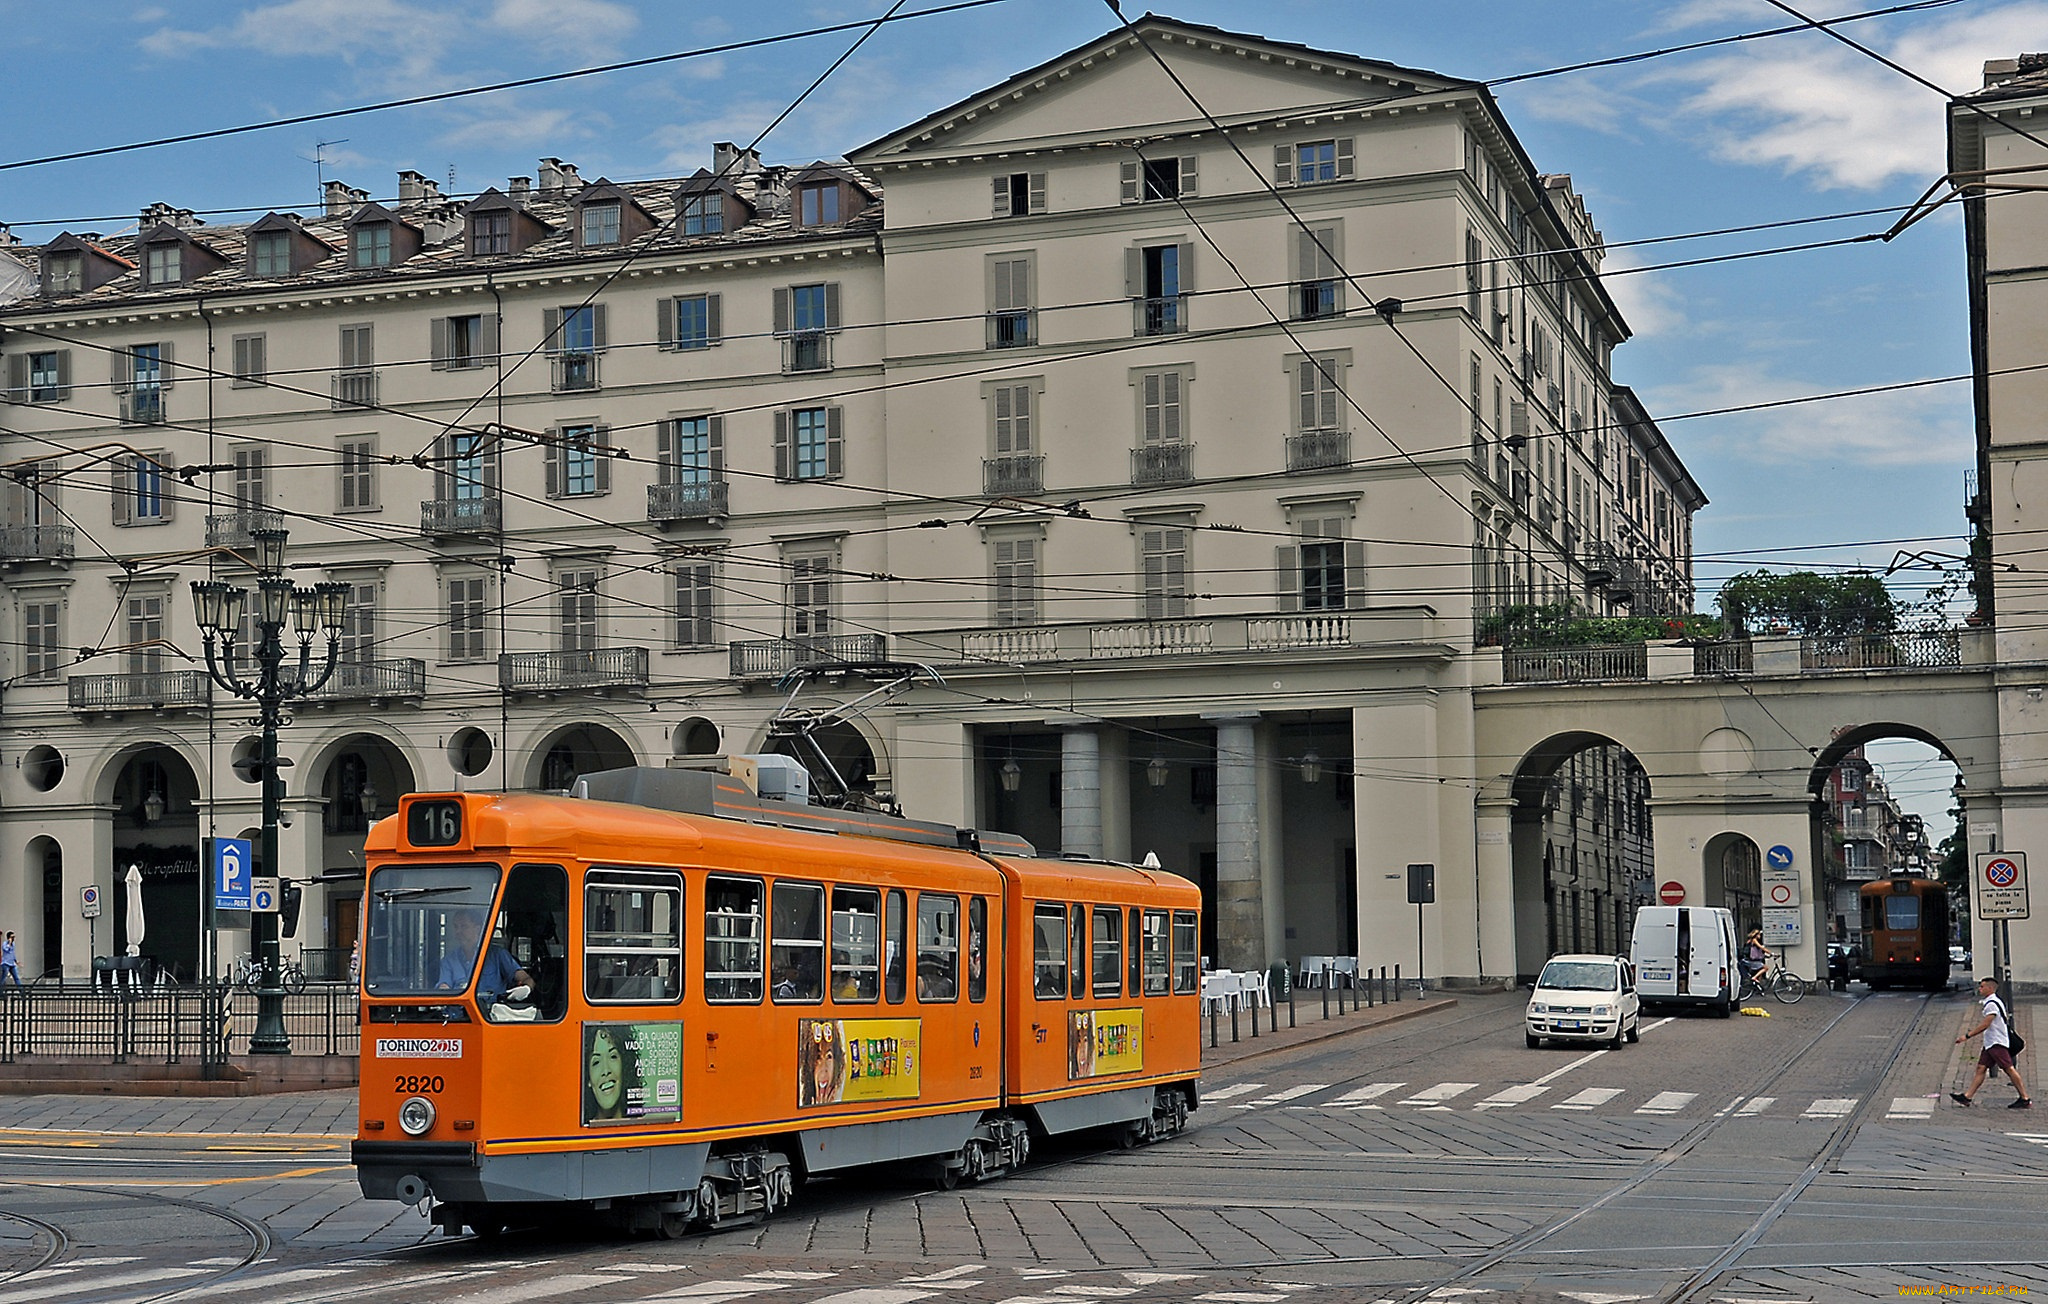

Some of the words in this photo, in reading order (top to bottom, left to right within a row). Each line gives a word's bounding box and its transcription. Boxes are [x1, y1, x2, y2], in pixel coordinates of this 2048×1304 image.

[425, 807, 455, 839] 16
[223, 855, 240, 892] P
[639, 1031, 649, 1041] DA
[624, 1040, 645, 1050] VADO
[658, 1040, 679, 1049] PRIMO
[395, 1075, 445, 1094] 2820
[658, 1084, 676, 1094] PRIMO
